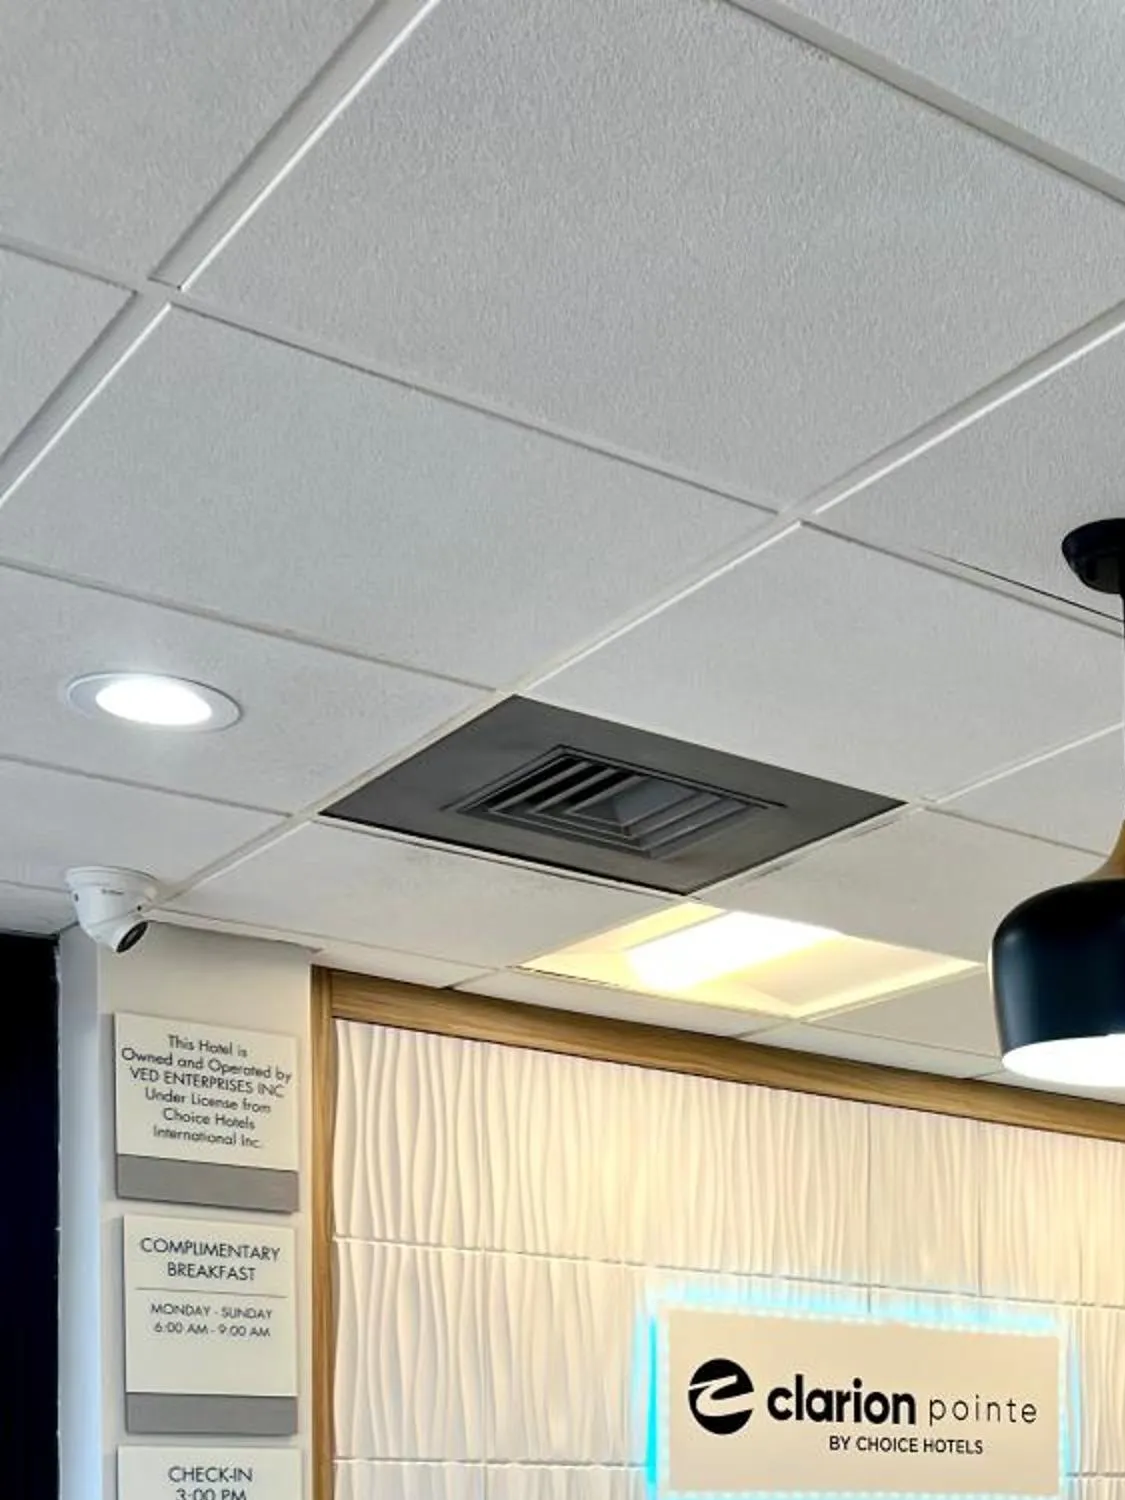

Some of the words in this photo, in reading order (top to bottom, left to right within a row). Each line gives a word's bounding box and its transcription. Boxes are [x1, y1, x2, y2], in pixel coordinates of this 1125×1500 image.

[168, 1034, 194, 1051] This
[200, 1039, 232, 1056] Hotel
[237, 1044, 247, 1057] is
[121, 1047, 172, 1066] Owned
[177, 1056, 203, 1070] and
[208, 1059, 271, 1080] Operated
[275, 1066, 292, 1084] by
[129, 1067, 159, 1081] VED
[164, 1071, 252, 1094] ENTERPRISES
[258, 1083, 285, 1098] INC
[145, 1087, 185, 1103] Under
[191, 1093, 238, 1111] License
[243, 1098, 271, 1113] from
[163, 1107, 210, 1125] Choice
[215, 1113, 255, 1130] Hotels
[154, 1125, 237, 1146] International
[140, 1237, 281, 1262] COMPLIMENTARY
[167, 1262, 257, 1281] BREAKFAST
[151, 1303, 211, 1317] MONDAY
[221, 1307, 273, 1319] SUNDAY
[153, 1321, 183, 1333] 6:00
[187, 1323, 209, 1334] AM
[249, 1325, 271, 1337] AM
[767, 1373, 916, 1425] clarion
[929, 1394, 1037, 1426] pointe
[829, 1435, 850, 1450] BY
[856, 1436, 918, 1453] CHOICE
[923, 1438, 984, 1455] HOTELS
[168, 1466, 253, 1483] CHECK-IN
